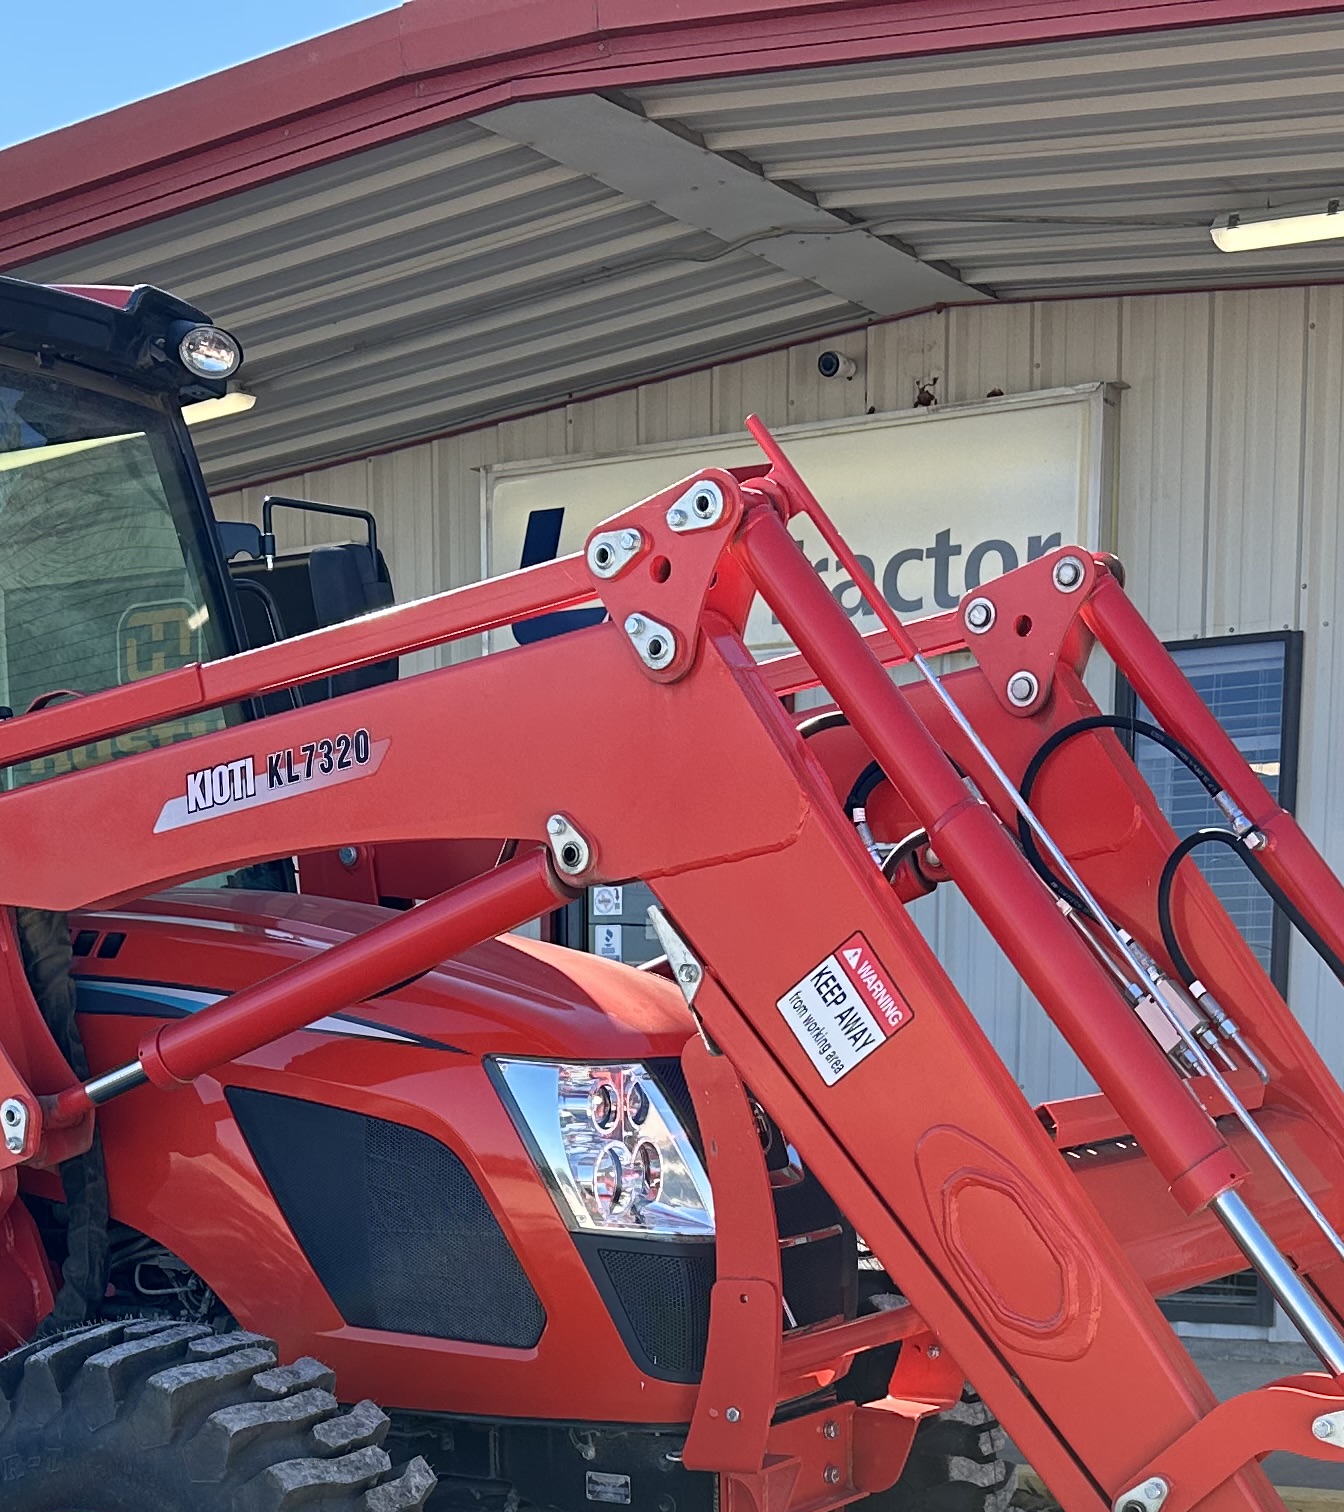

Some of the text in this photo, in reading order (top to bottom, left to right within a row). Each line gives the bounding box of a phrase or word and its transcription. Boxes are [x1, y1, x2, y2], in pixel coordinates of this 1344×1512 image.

[187, 728, 371, 814] KIOTI KL7320
[788, 990, 845, 1075] from working area
[810, 965, 876, 1052] KEEP AWAY
[857, 960, 903, 1027] WARNING
